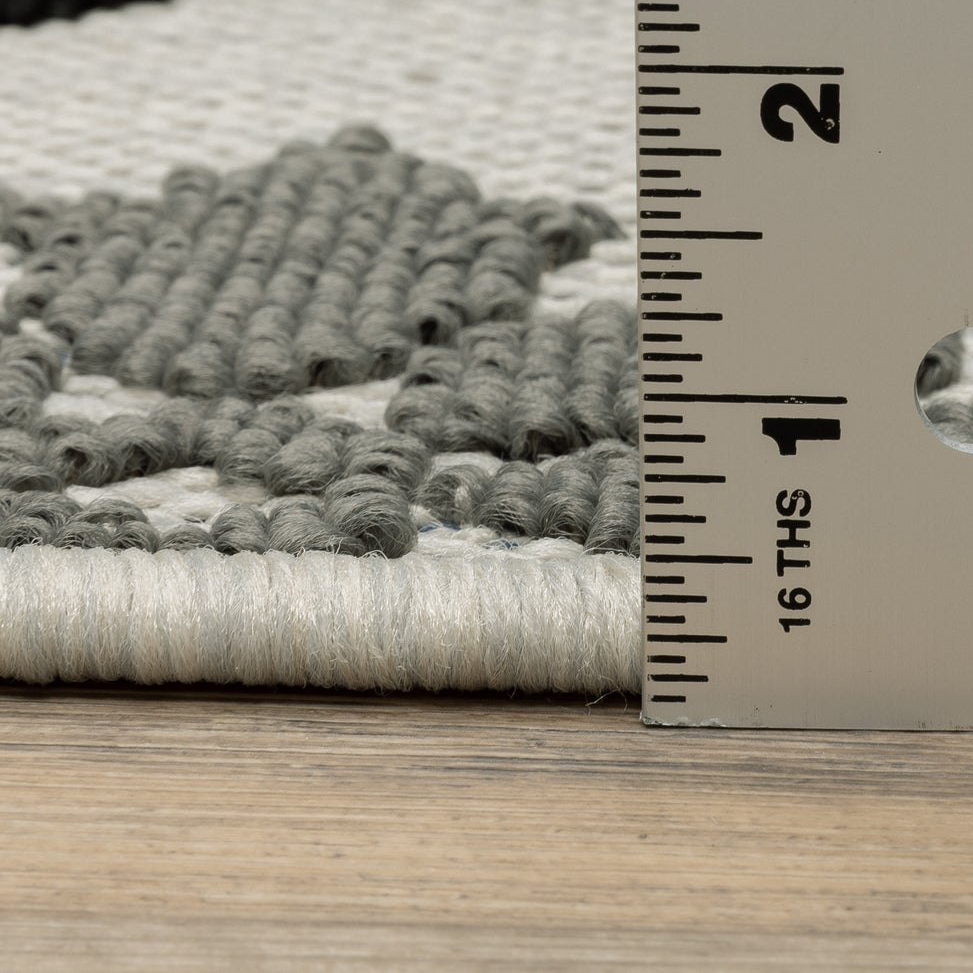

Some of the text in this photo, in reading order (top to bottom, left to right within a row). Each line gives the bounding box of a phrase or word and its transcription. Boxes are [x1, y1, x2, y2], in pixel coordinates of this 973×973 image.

[759, 82, 841, 145] 2
[761, 416, 842, 457] 1
[775, 488, 812, 633] 16 THS
